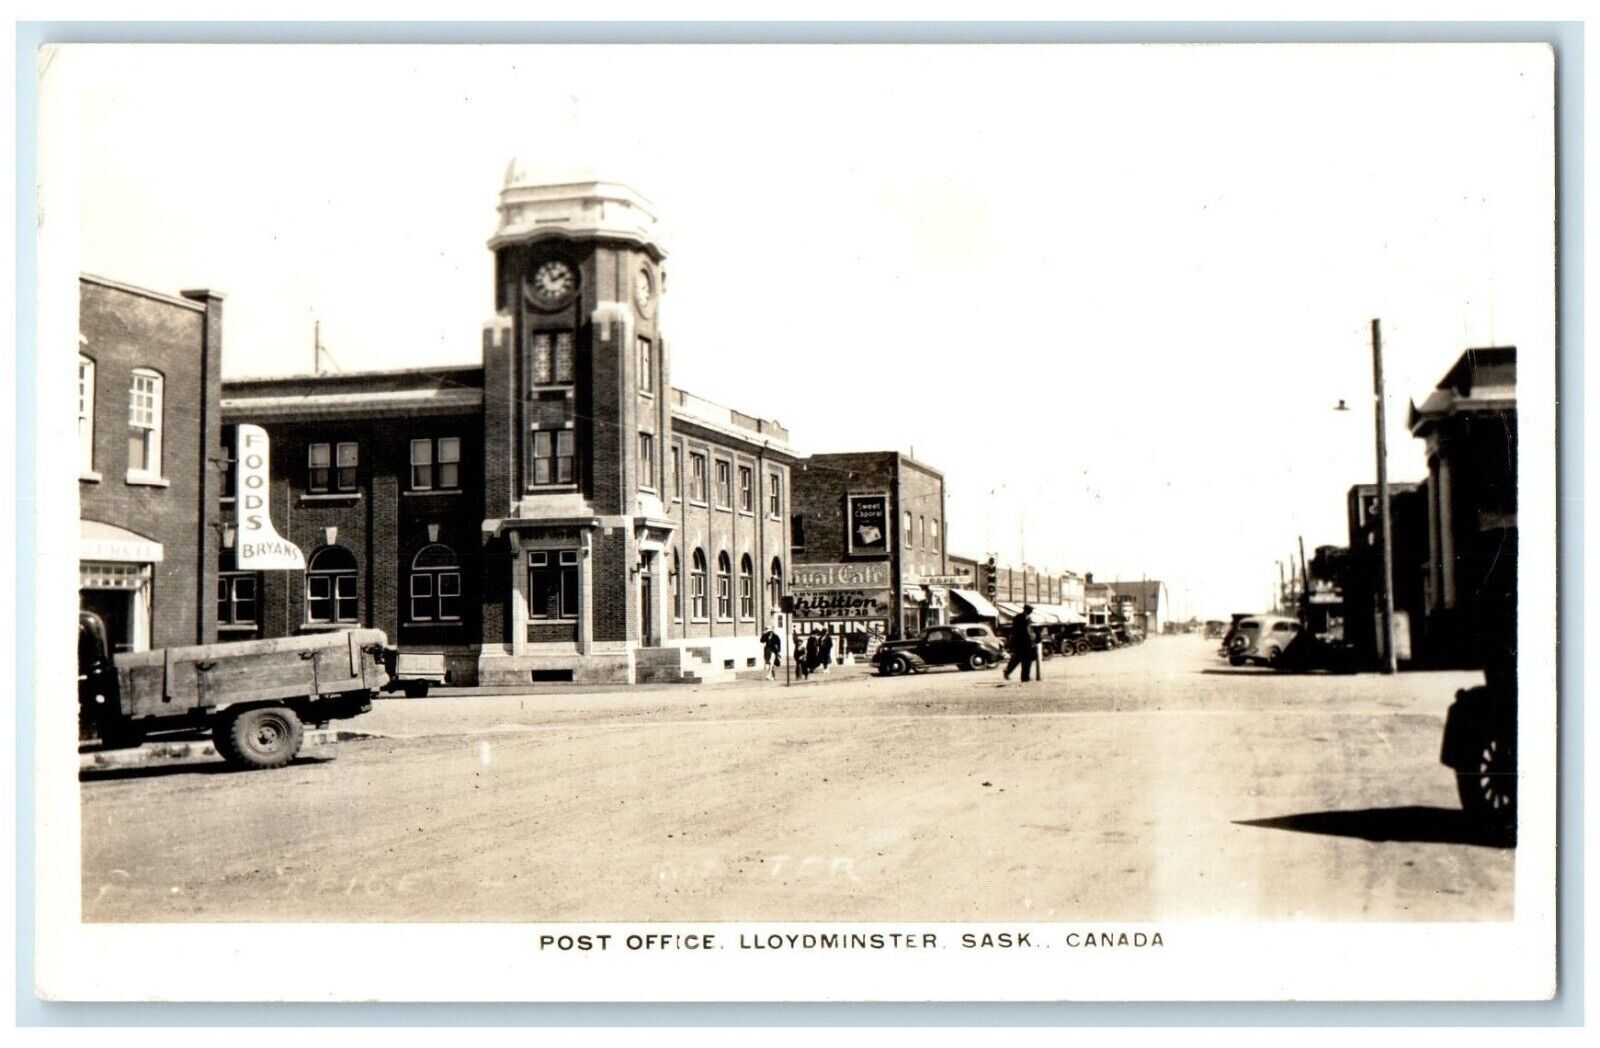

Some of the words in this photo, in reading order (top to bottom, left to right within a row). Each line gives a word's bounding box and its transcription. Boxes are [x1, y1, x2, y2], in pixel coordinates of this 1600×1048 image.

[245, 434, 264, 531] FOODS
[243, 541, 298, 560] BRYANS
[795, 596, 877, 609] hibition
[792, 621, 884, 634] RINTING
